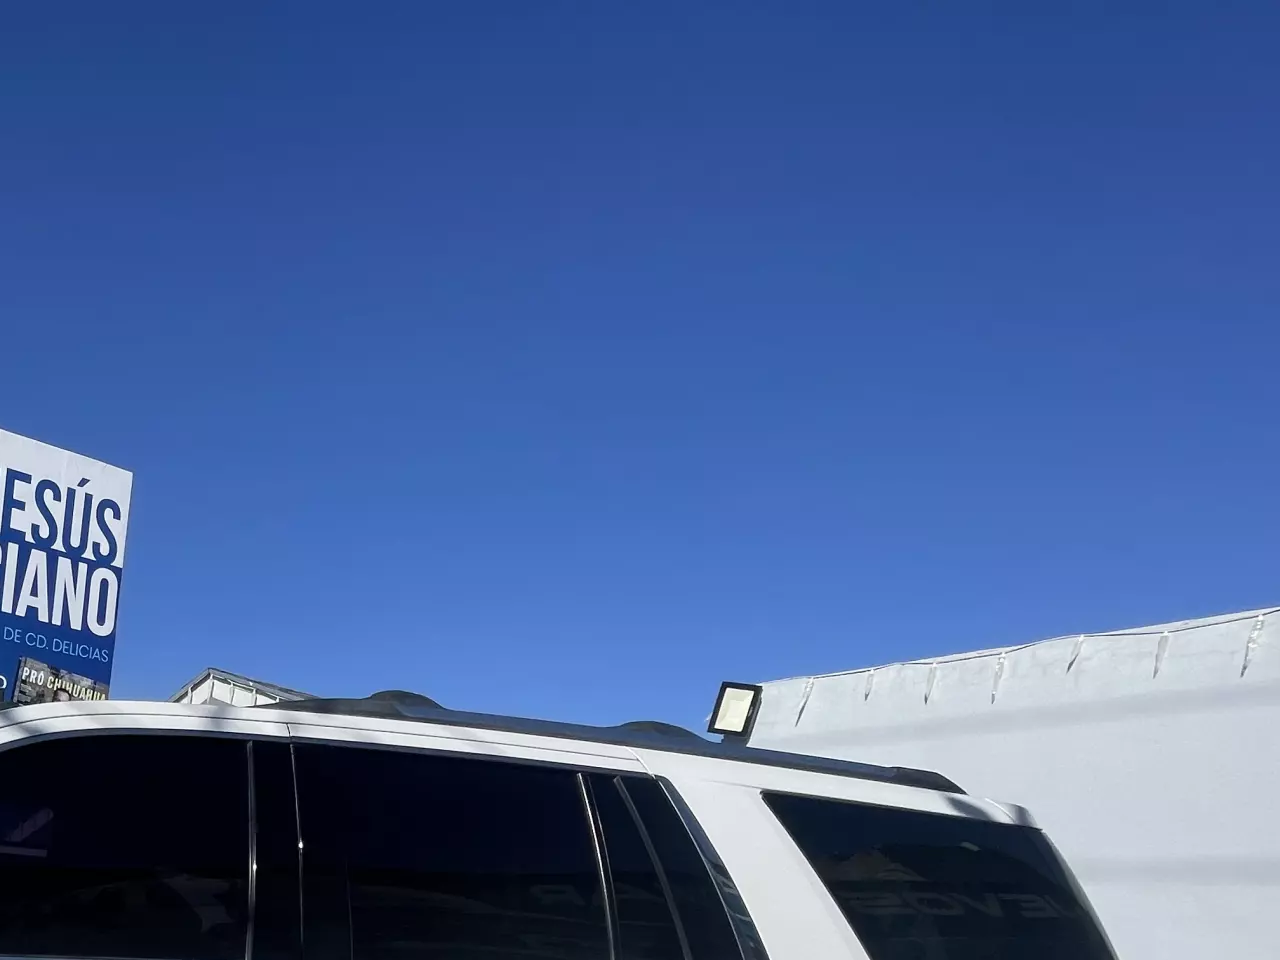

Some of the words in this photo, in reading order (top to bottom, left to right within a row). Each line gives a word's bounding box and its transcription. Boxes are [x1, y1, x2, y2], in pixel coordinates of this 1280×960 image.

[3, 627, 21, 643] DE
[25, 632, 49, 650] CD.
[53, 638, 109, 663] DELICIAS
